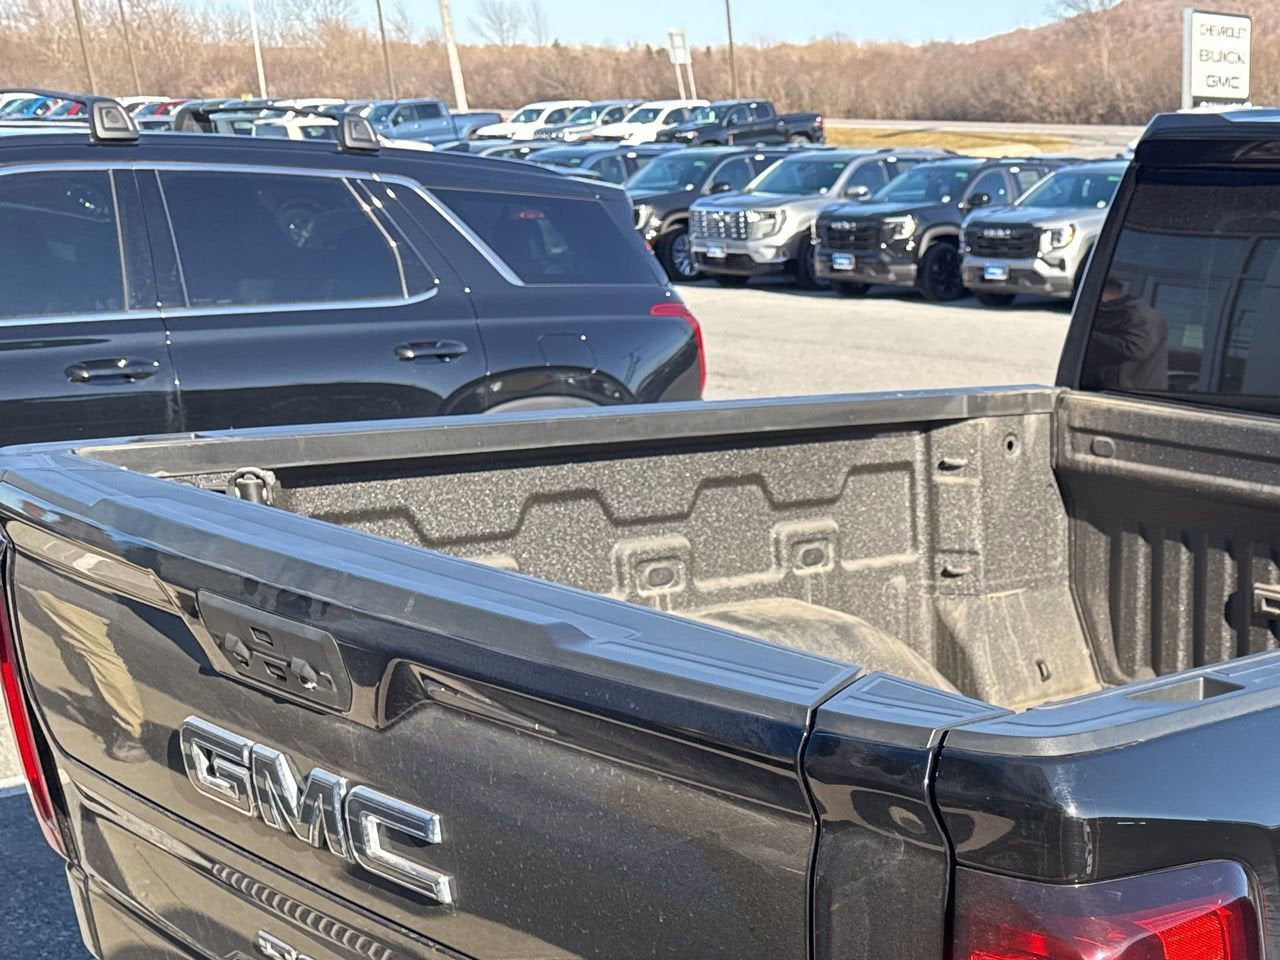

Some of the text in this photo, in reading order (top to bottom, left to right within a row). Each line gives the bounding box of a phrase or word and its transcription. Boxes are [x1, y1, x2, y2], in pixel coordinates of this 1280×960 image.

[1200, 24, 1247, 39] CHEVROLET
[1199, 49, 1246, 65] BUICK
[1206, 75, 1240, 89] GMC
[180, 715, 455, 905] GMC
